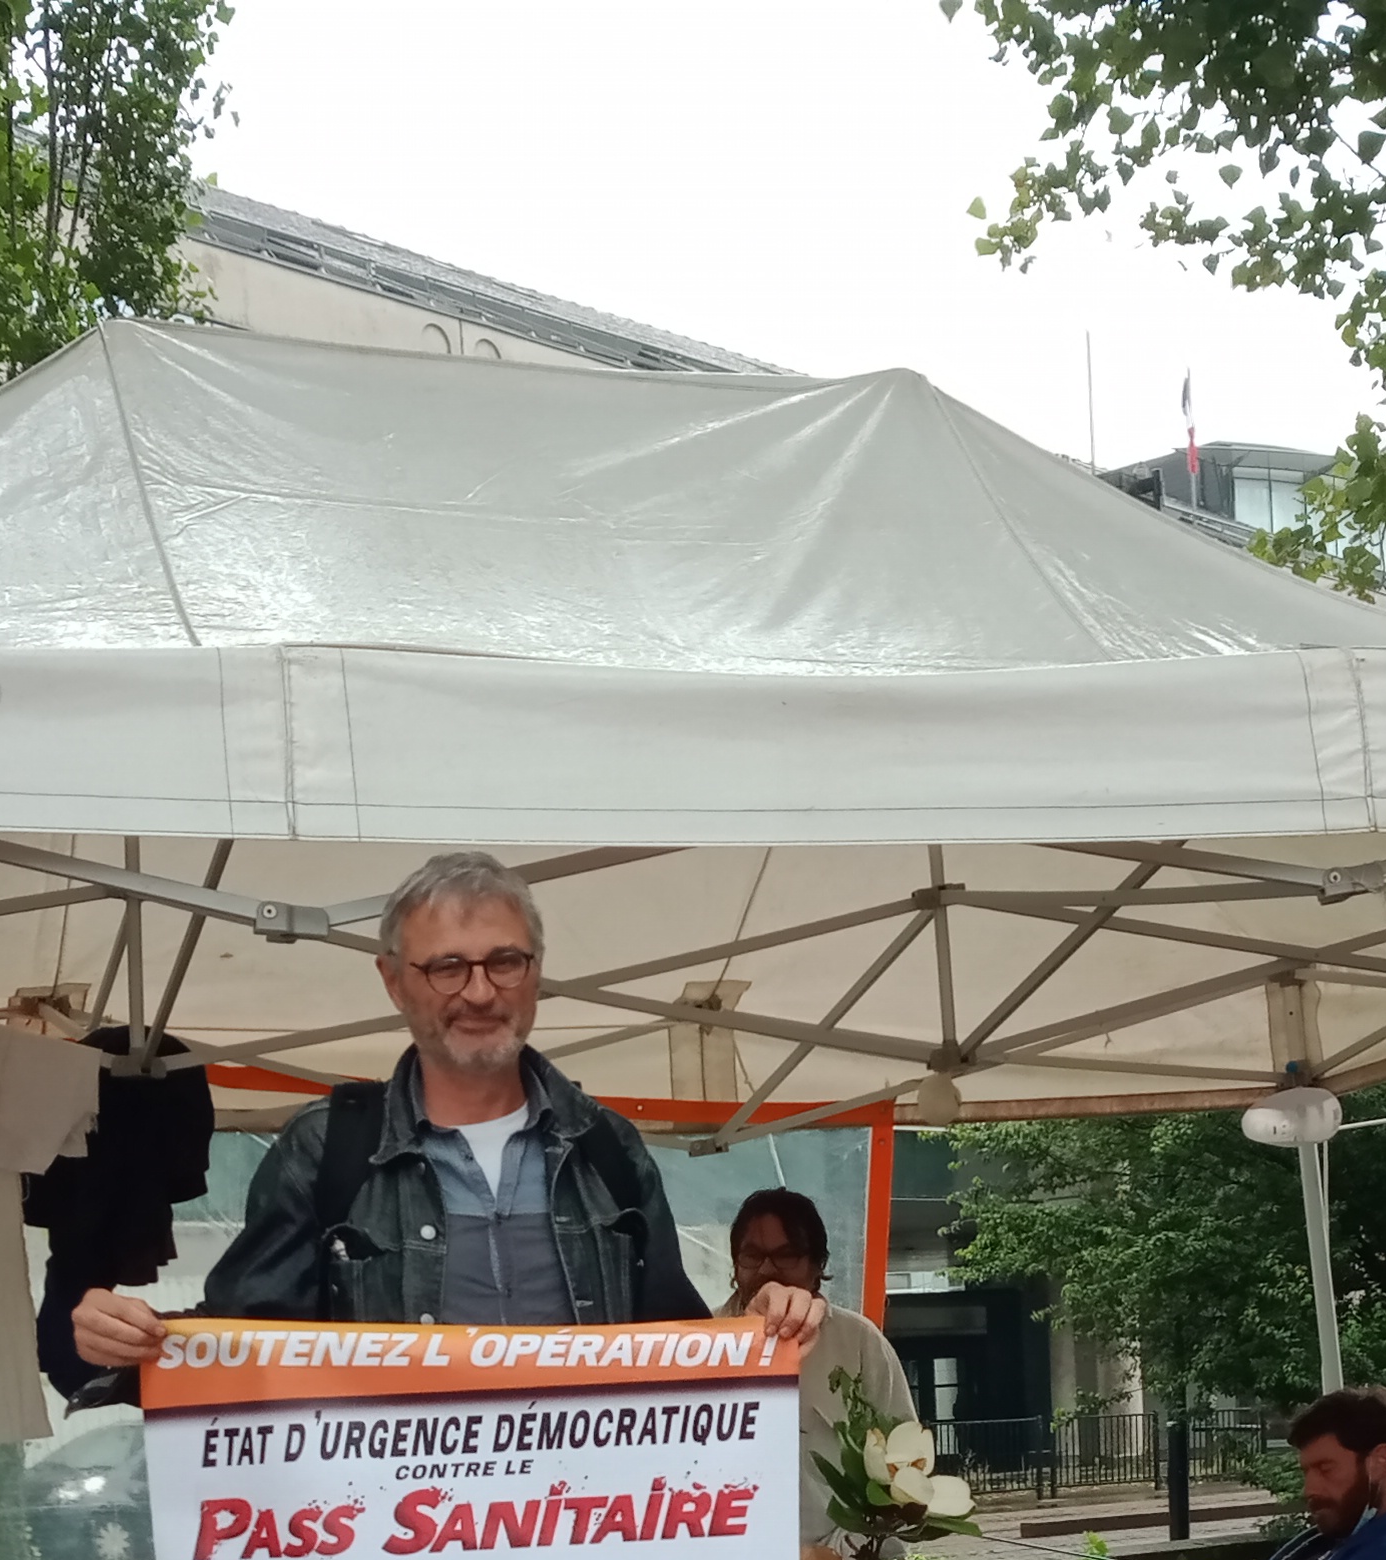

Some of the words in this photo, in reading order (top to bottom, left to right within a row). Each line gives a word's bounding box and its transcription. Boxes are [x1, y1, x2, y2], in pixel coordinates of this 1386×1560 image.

[156, 1331, 419, 1369] SOUTENEZ
[202, 1417, 274, 1468] ÉTAT
[492, 1401, 760, 1452] DÉMOCRATIQUE
[395, 1462, 497, 1480] CONTRE
[504, 1459, 534, 1476] LE
